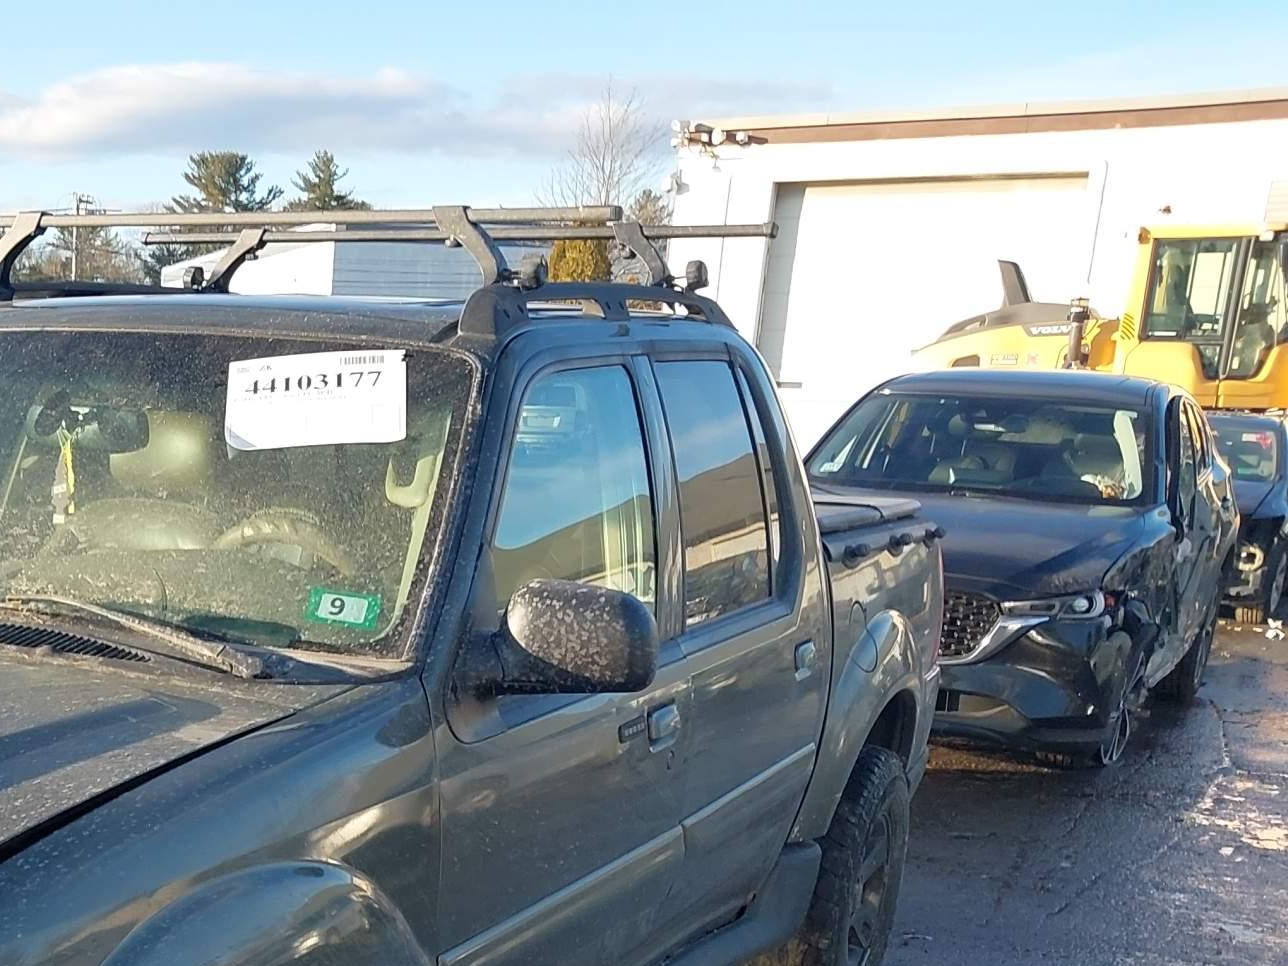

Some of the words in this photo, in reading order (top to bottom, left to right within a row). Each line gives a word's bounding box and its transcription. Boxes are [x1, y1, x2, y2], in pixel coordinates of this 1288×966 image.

[1029, 325, 1072, 336] VOLV
[245, 371, 382, 394] 44103177
[328, 597, 345, 616] 9
